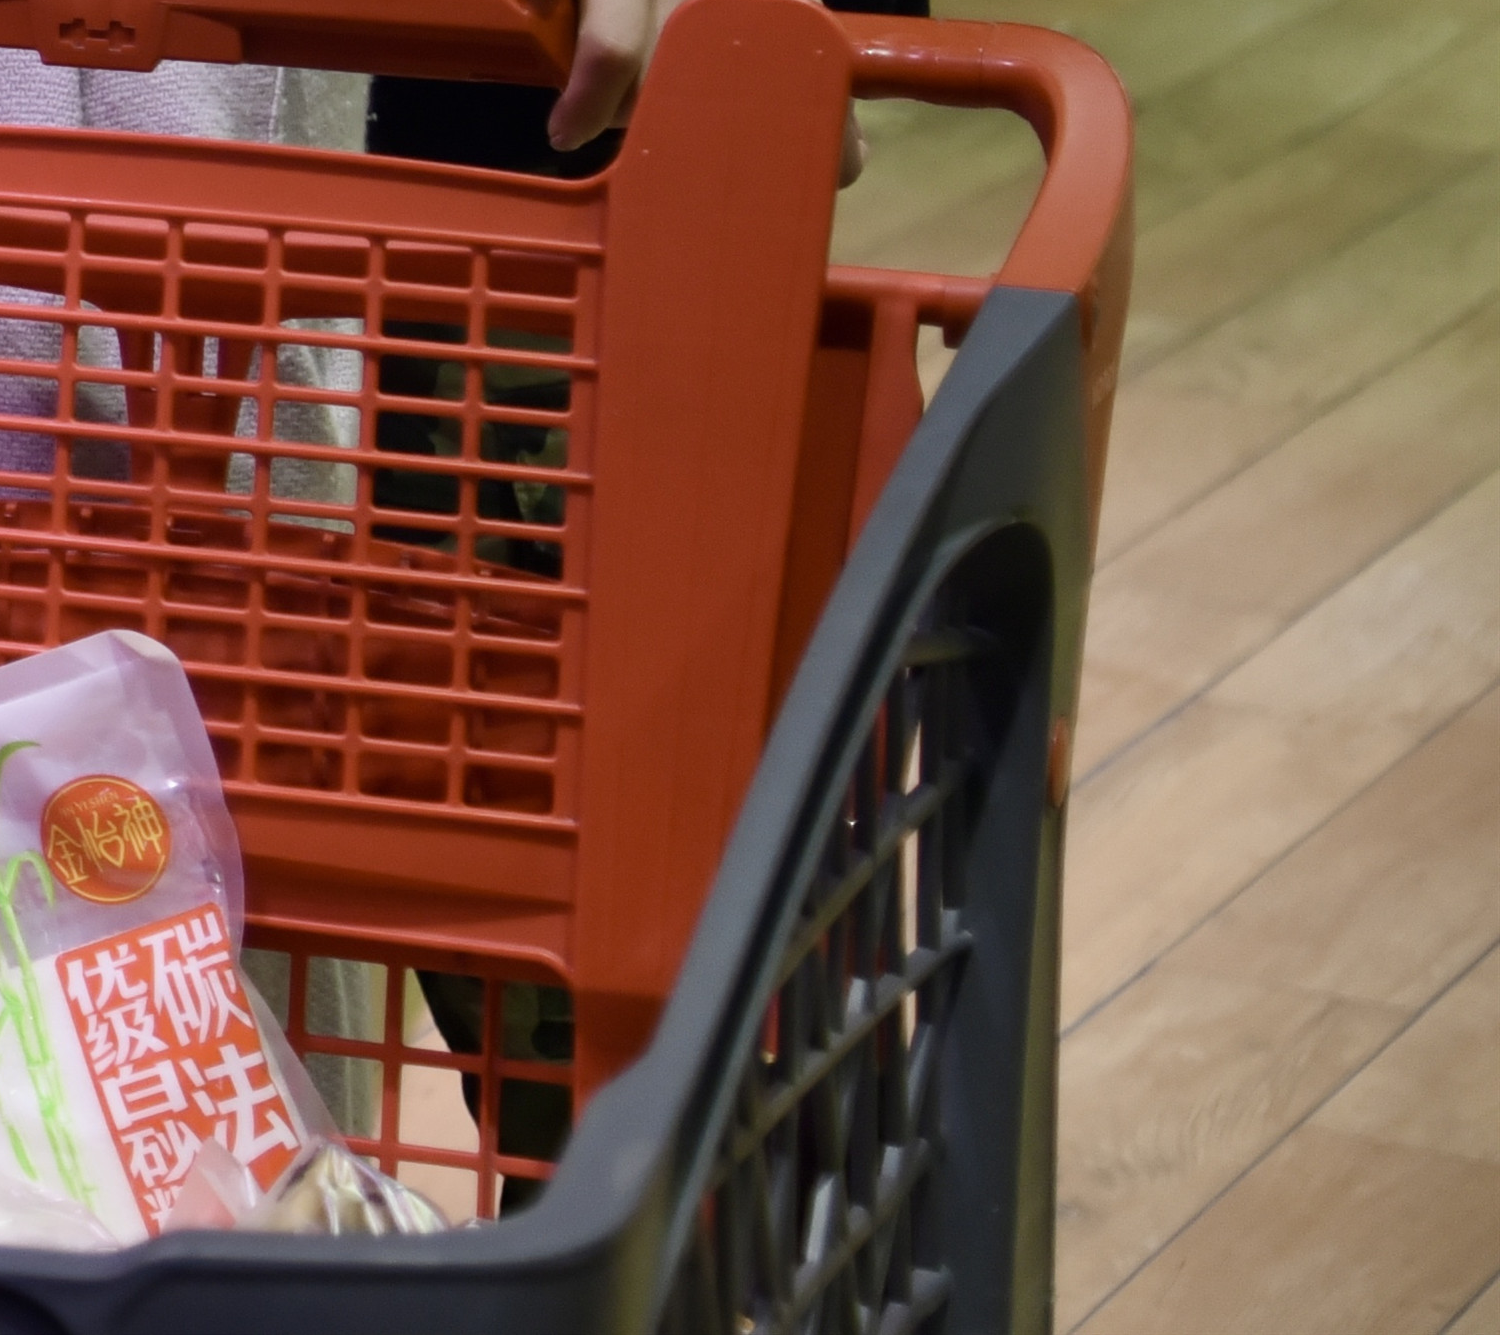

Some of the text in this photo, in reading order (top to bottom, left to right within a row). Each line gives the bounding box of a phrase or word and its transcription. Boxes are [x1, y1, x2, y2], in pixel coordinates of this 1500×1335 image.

[47, 796, 164, 886] 金怡神
[140, 912, 300, 1167] 碳法
